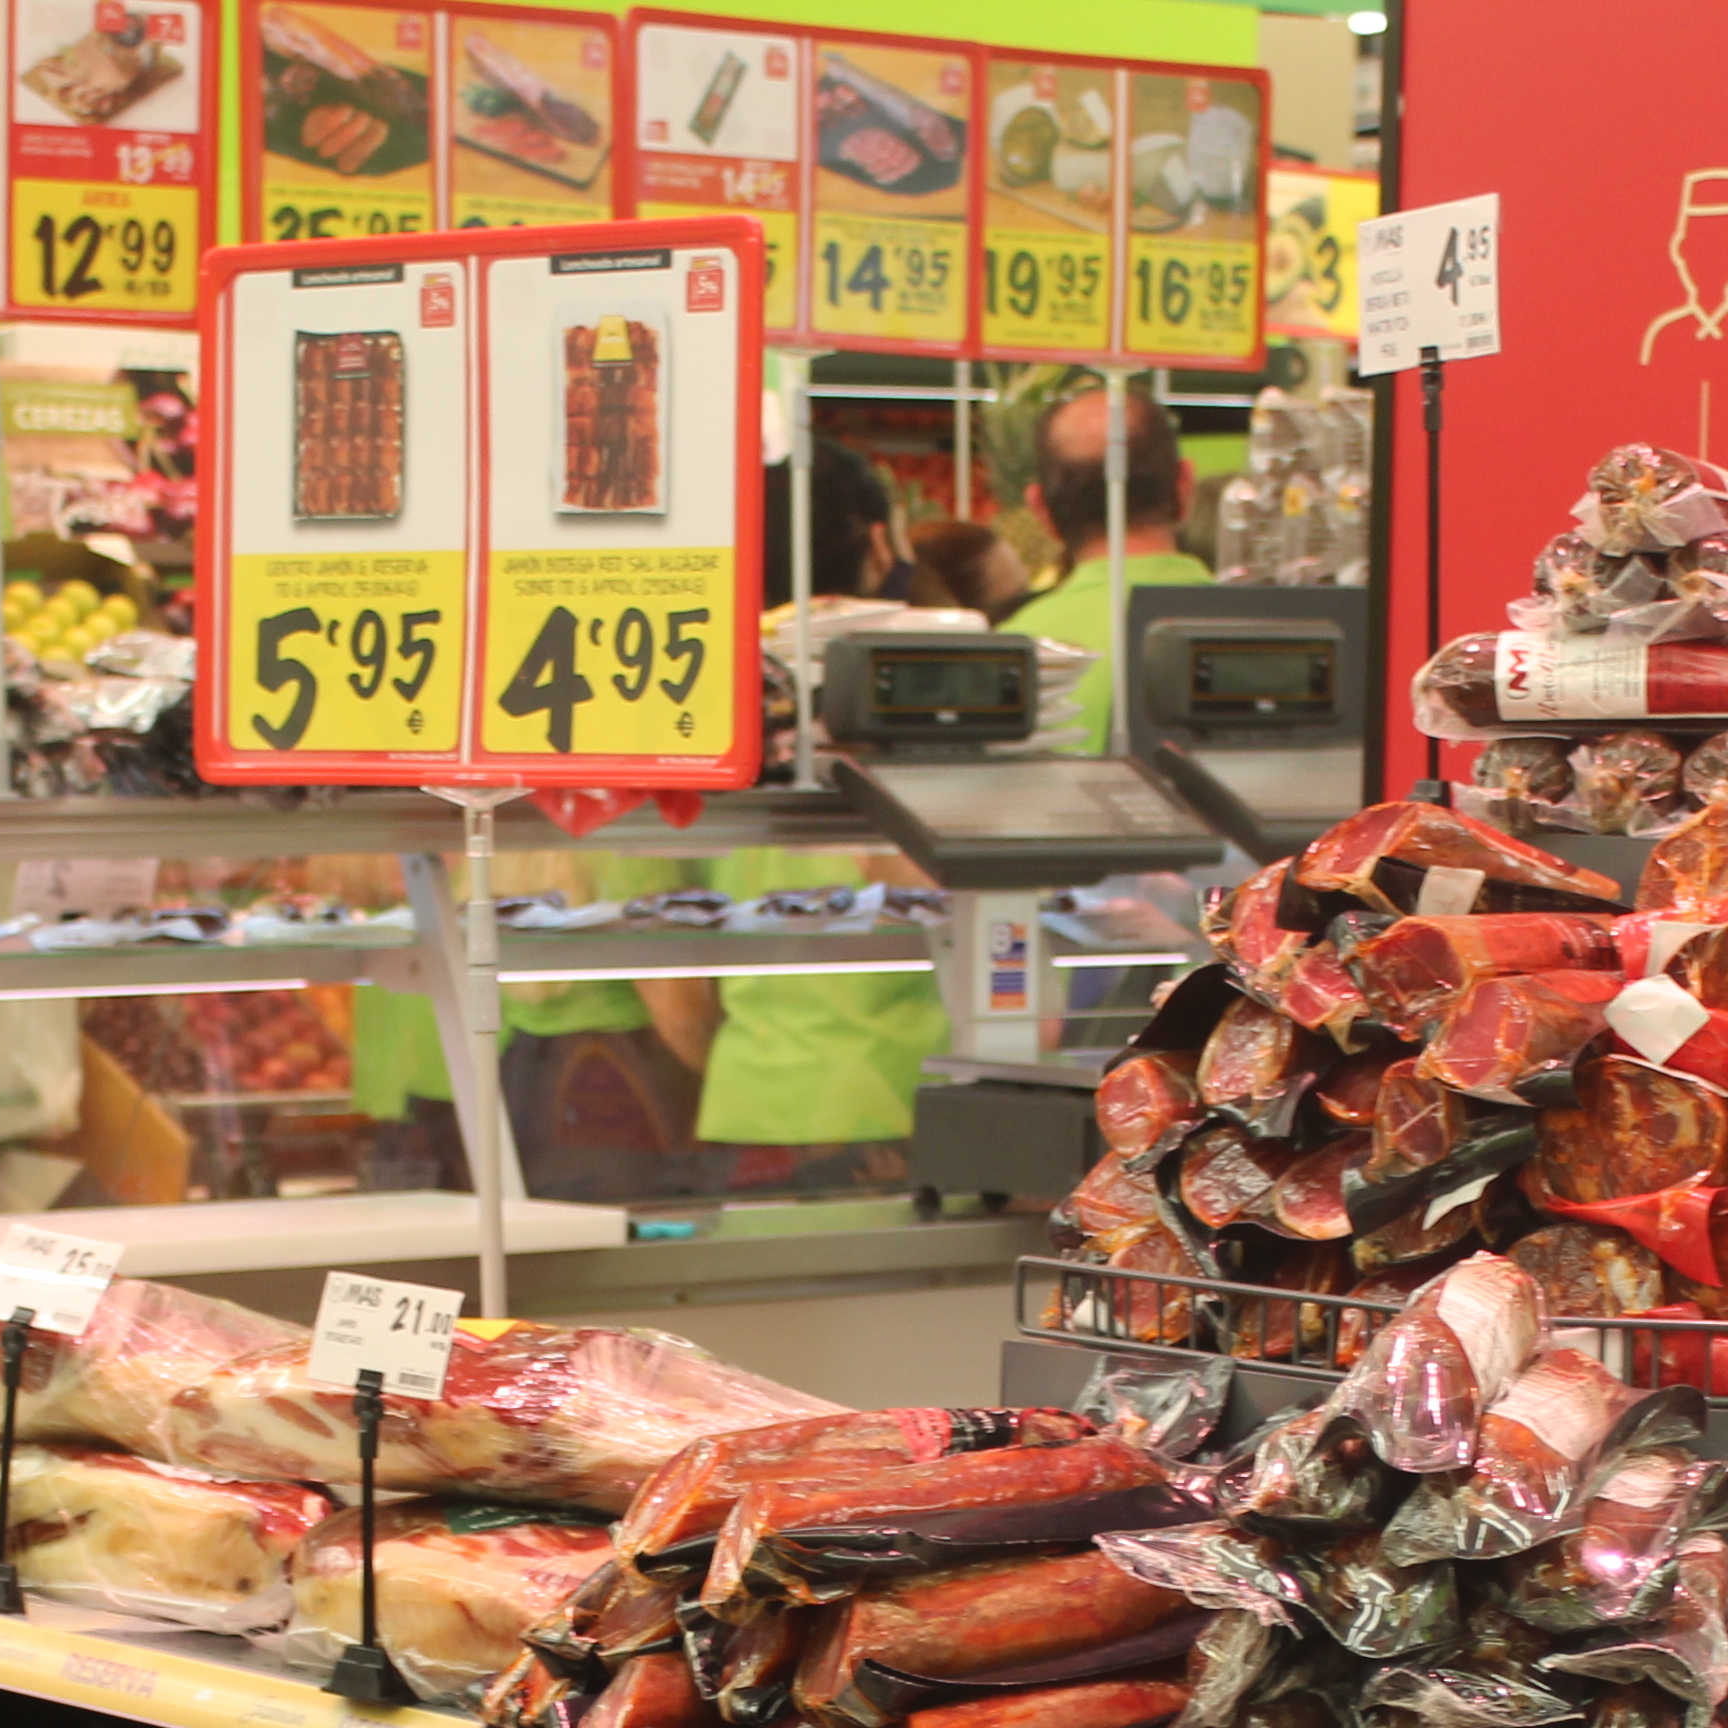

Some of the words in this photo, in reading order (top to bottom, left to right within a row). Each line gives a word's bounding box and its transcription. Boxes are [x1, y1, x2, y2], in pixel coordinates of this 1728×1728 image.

[34, 213, 176, 299] 12'99
[1434, 224, 1491, 306] 4.95
[252, 607, 442, 752] 5'95
[498, 606, 710, 753] 4'95
